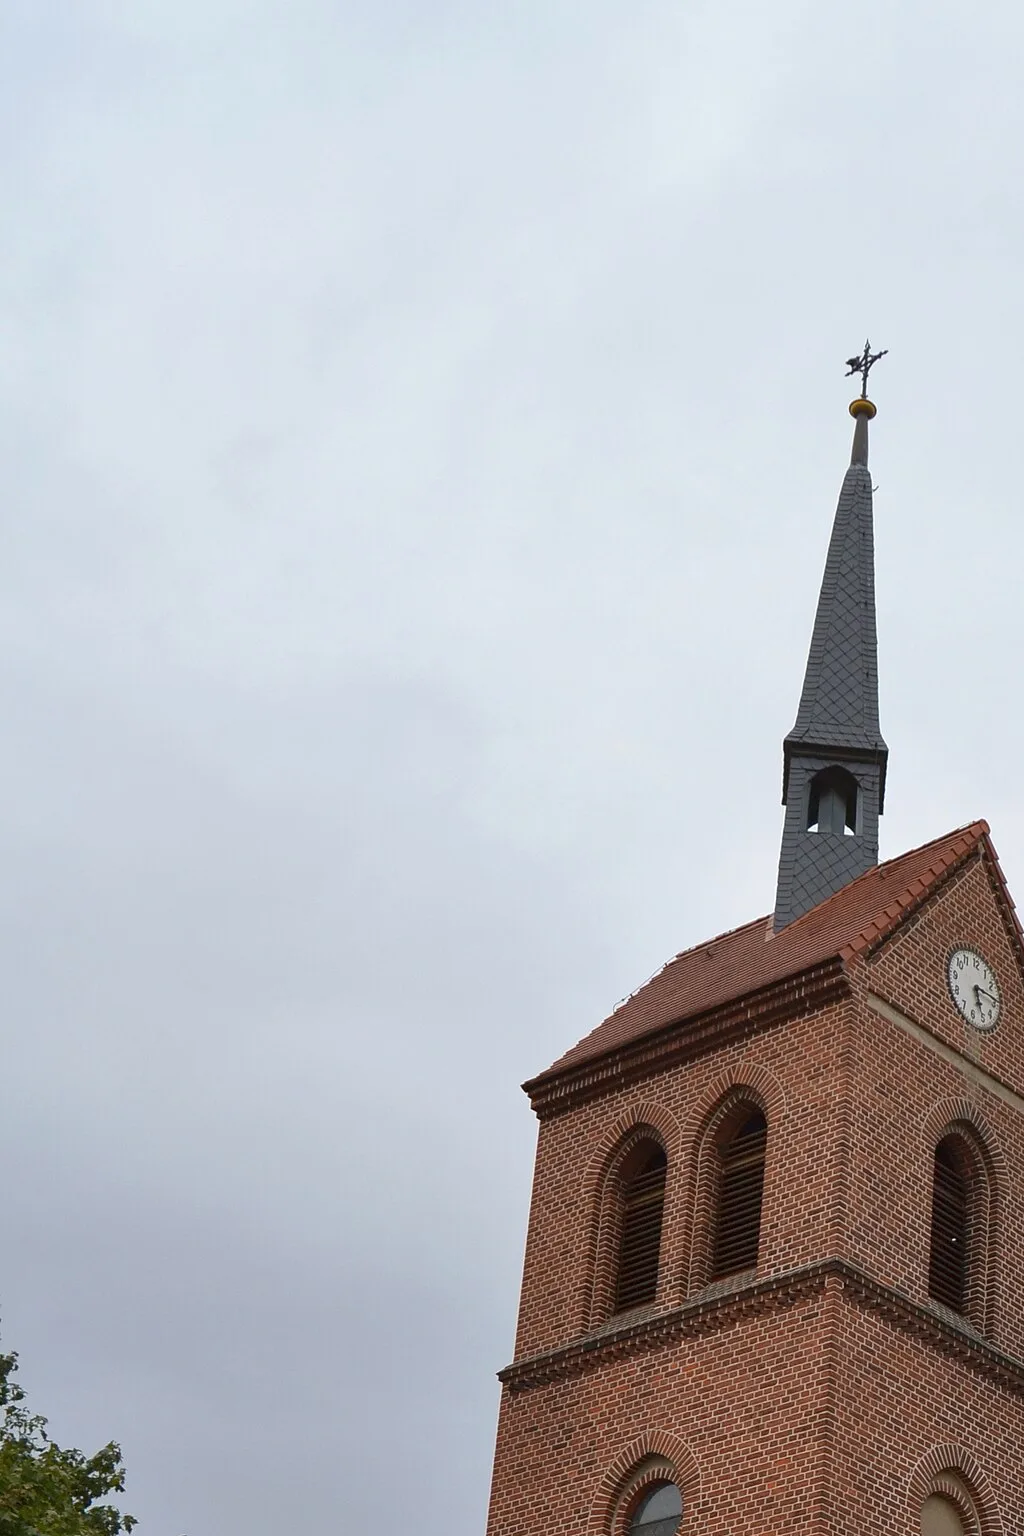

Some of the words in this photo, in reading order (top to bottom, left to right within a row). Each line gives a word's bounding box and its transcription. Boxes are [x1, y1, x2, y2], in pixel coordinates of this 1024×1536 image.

[957, 957, 964, 970] 10
[973, 958, 980, 971] 12
[953, 970, 958, 980] 9
[955, 985, 959, 995] 8
[989, 981, 993, 991] 2
[962, 999, 966, 1010] 7
[970, 1009, 975, 1019] 6
[981, 1012, 986, 1023] 5
[988, 1009, 992, 1020] 4
